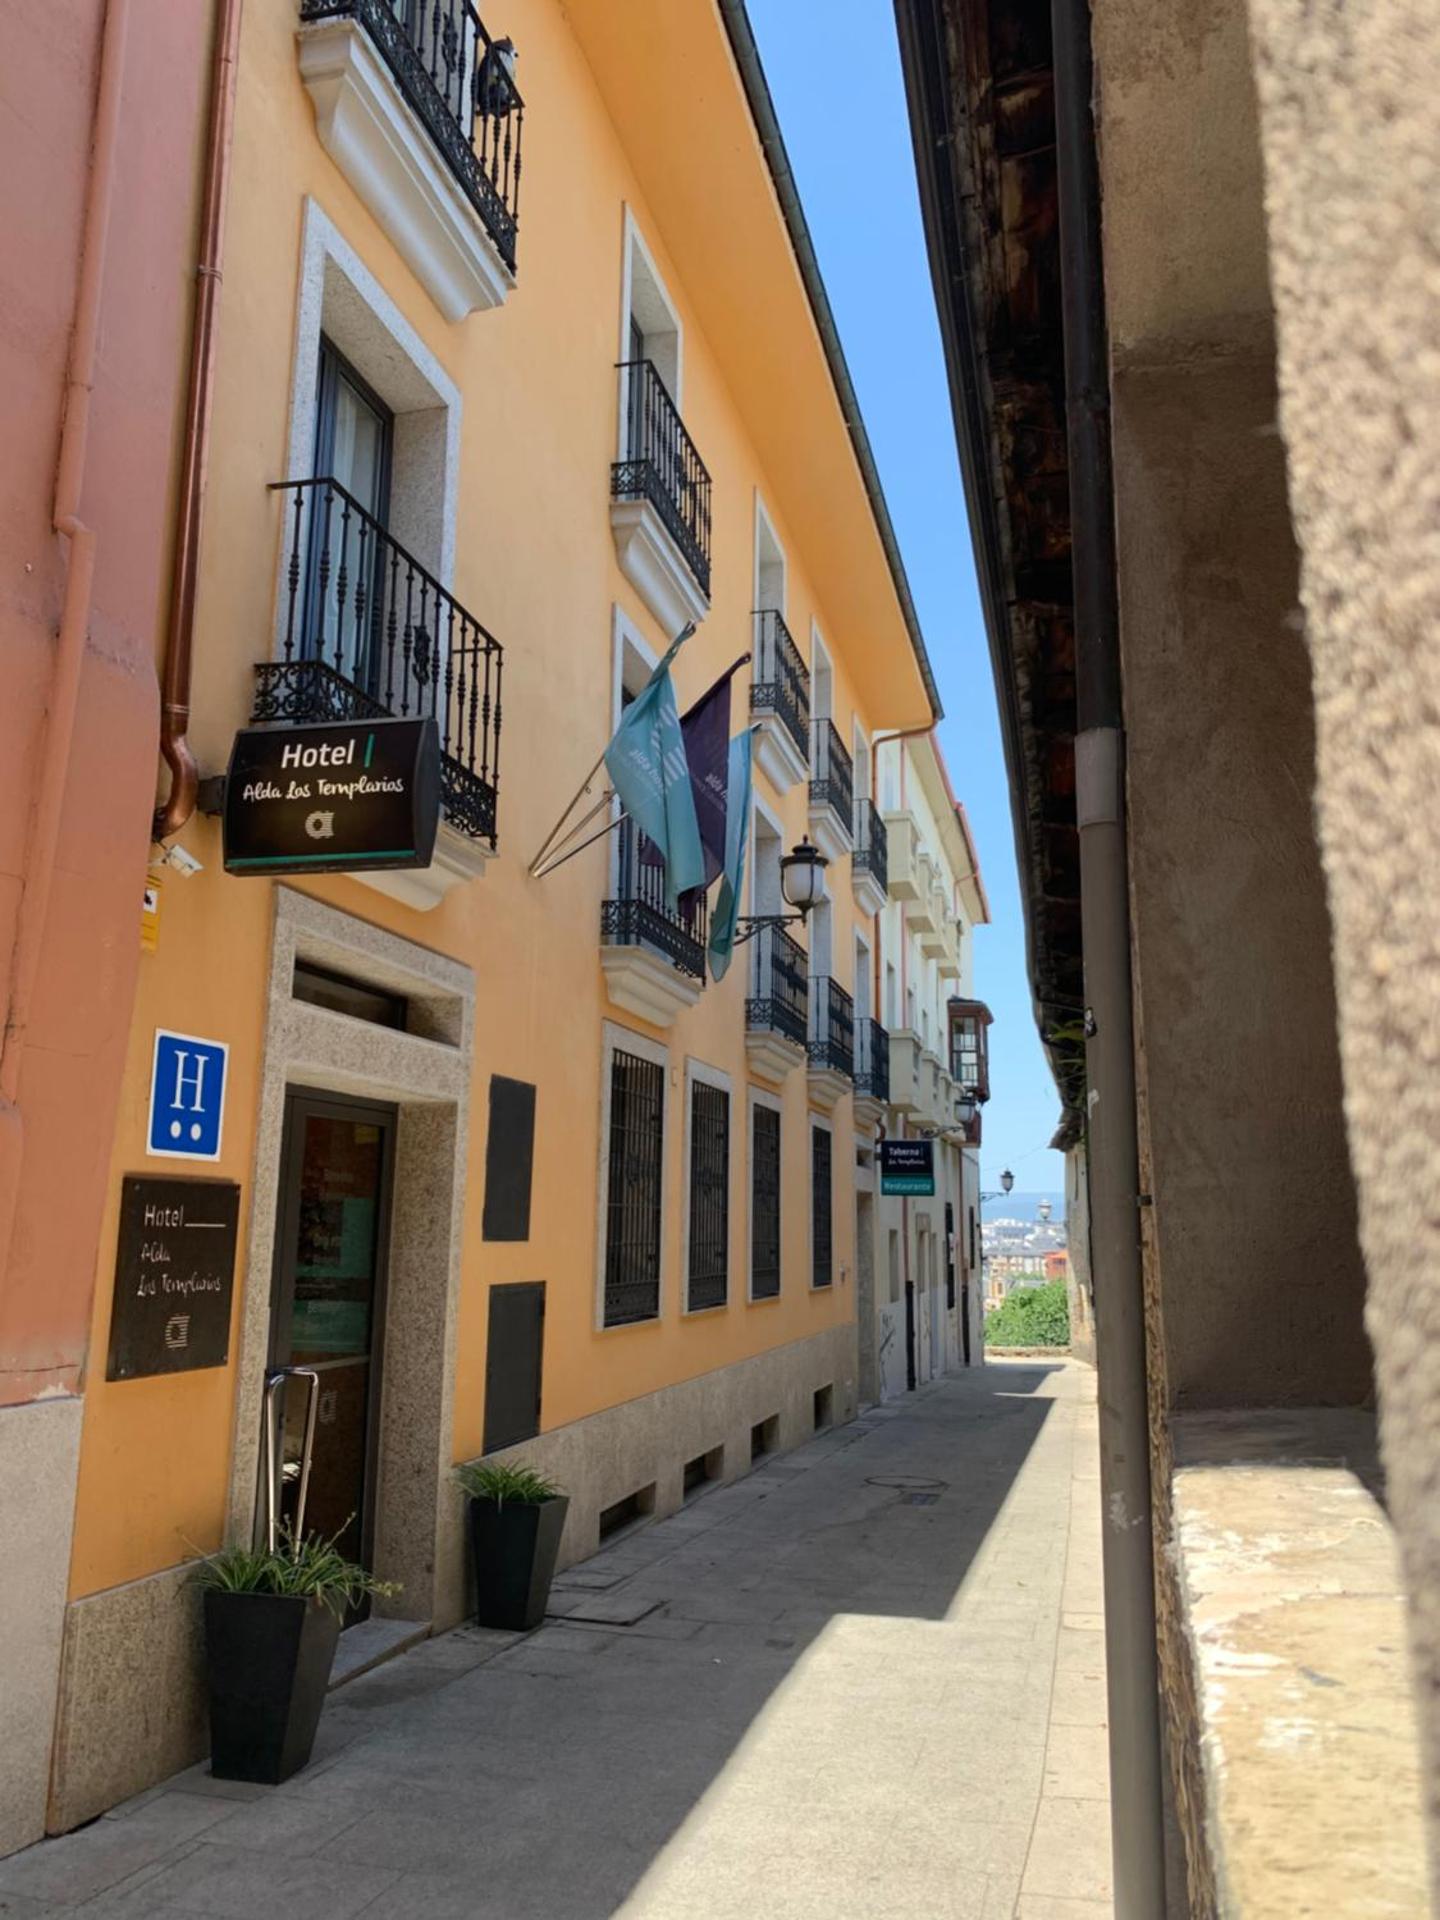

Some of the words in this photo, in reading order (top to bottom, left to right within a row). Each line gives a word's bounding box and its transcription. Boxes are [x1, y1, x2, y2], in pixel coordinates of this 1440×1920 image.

[281, 738, 356, 769] Hotel
[243, 781, 282, 802] Alda
[286, 780, 311, 800] Los
[317, 775, 404, 800] Templarios
[169, 1049, 209, 1112] H
[888, 1147, 920, 1156] Taberna
[144, 1204, 184, 1227] Hotel
[141, 1242, 171, 1262] Alda
[137, 1274, 157, 1297] Los
[161, 1271, 221, 1298] Templarios
